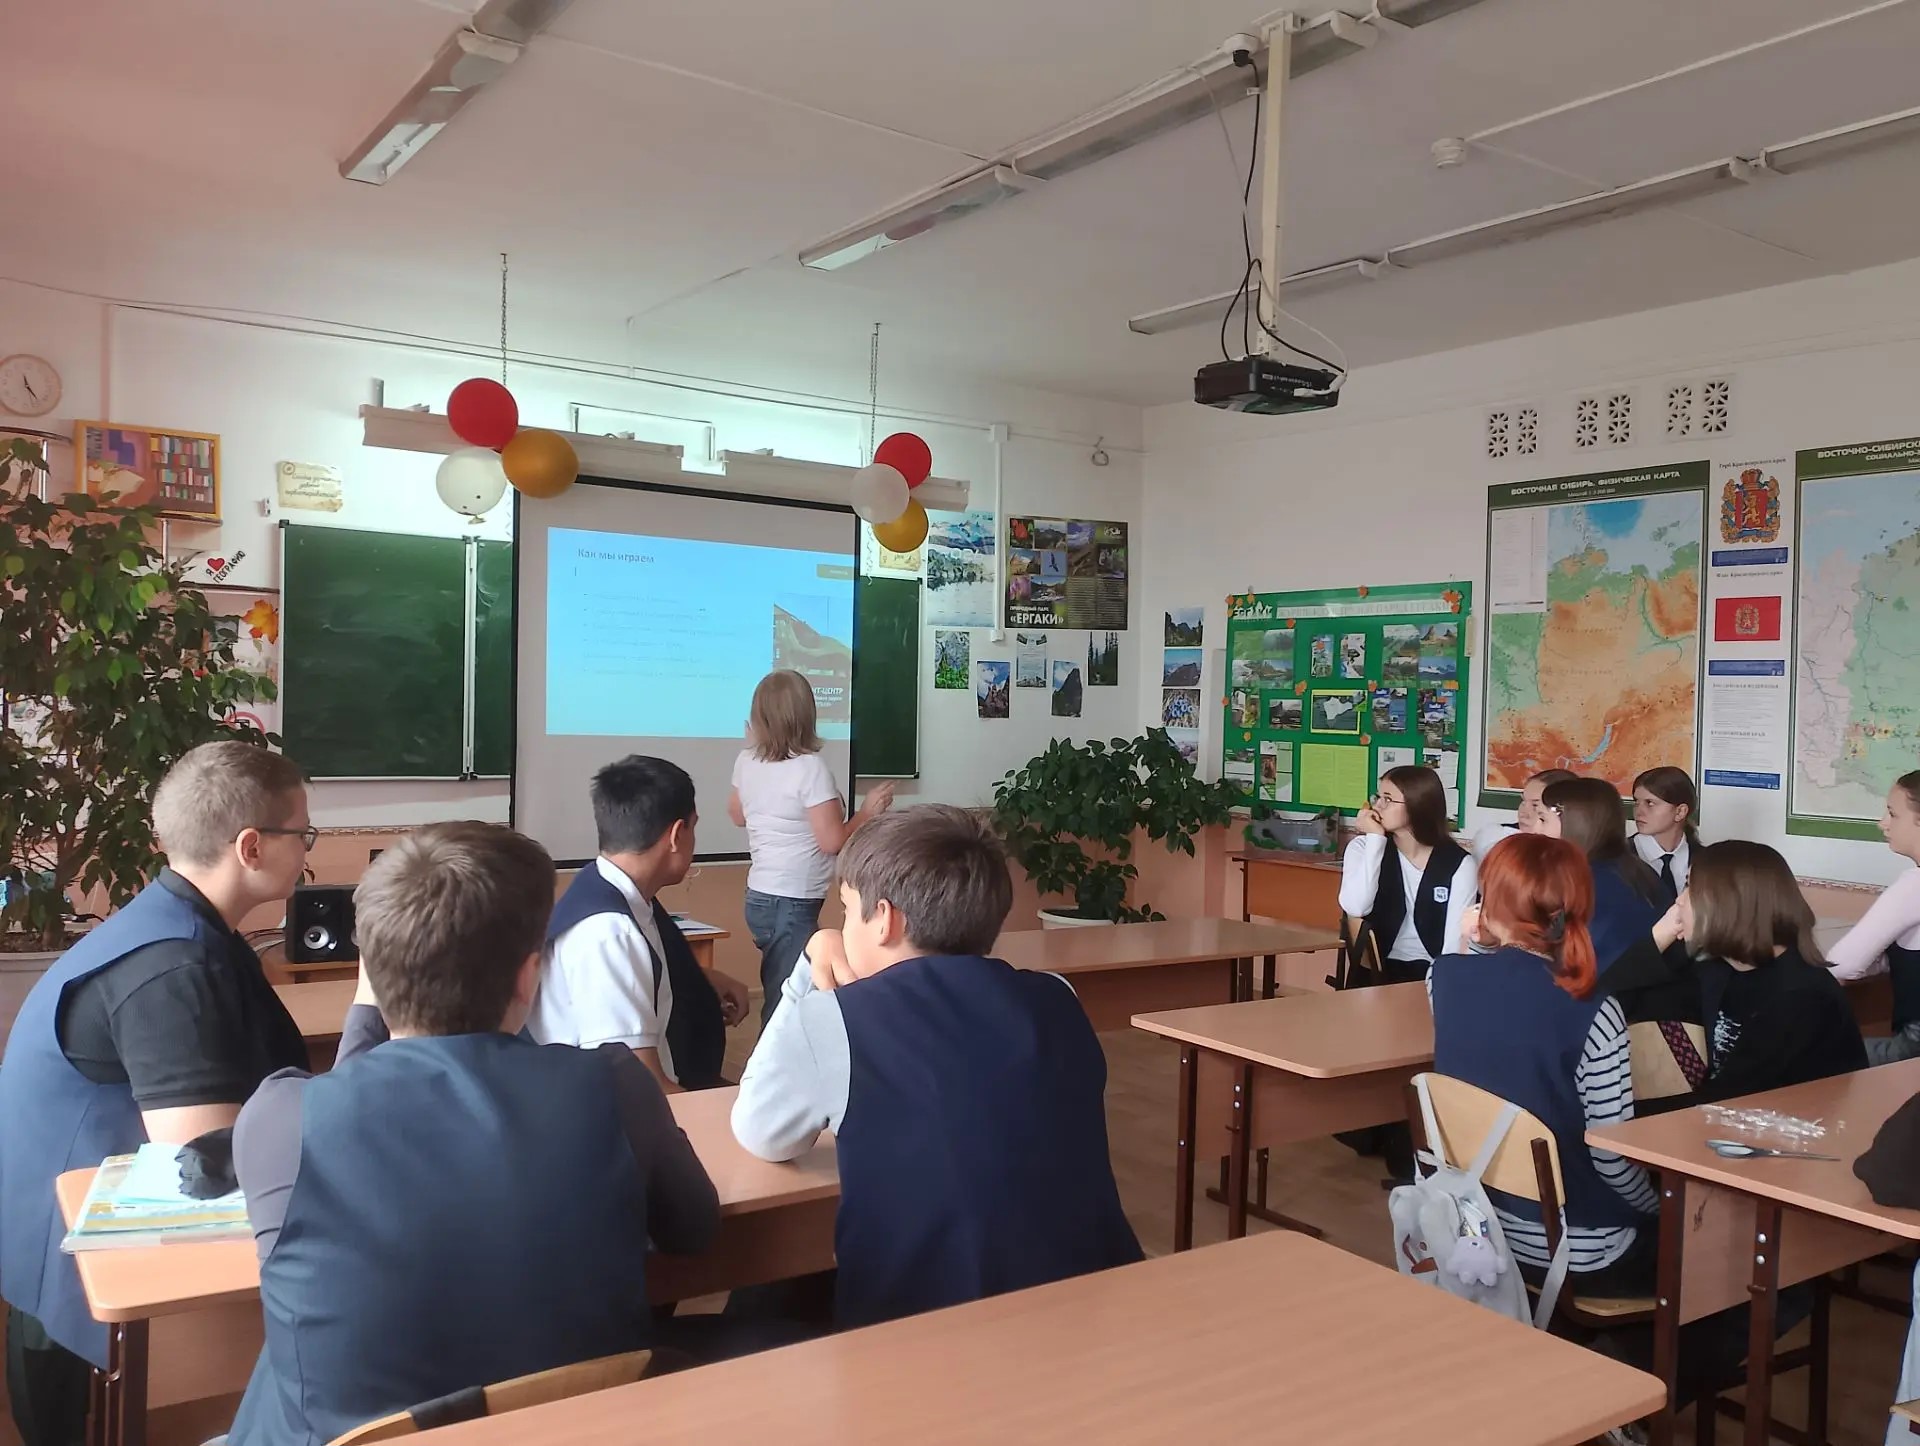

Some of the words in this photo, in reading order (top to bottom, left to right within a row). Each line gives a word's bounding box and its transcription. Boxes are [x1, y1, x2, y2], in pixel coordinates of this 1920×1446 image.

[1511, 484, 1558, 496] ВОСТОЧНАЯ
[1598, 474, 1651, 486] ФИЗИЧЕСКАЯ
[1654, 471, 1680, 480] КАРТА
[578, 548, 596, 559] Как
[600, 552, 615, 560] мы
[618, 554, 654, 564] играем
[212, 550, 246, 584] ГЕОГРАФИЮ
[1010, 612, 1064, 625] «ЕРГАКИ»
